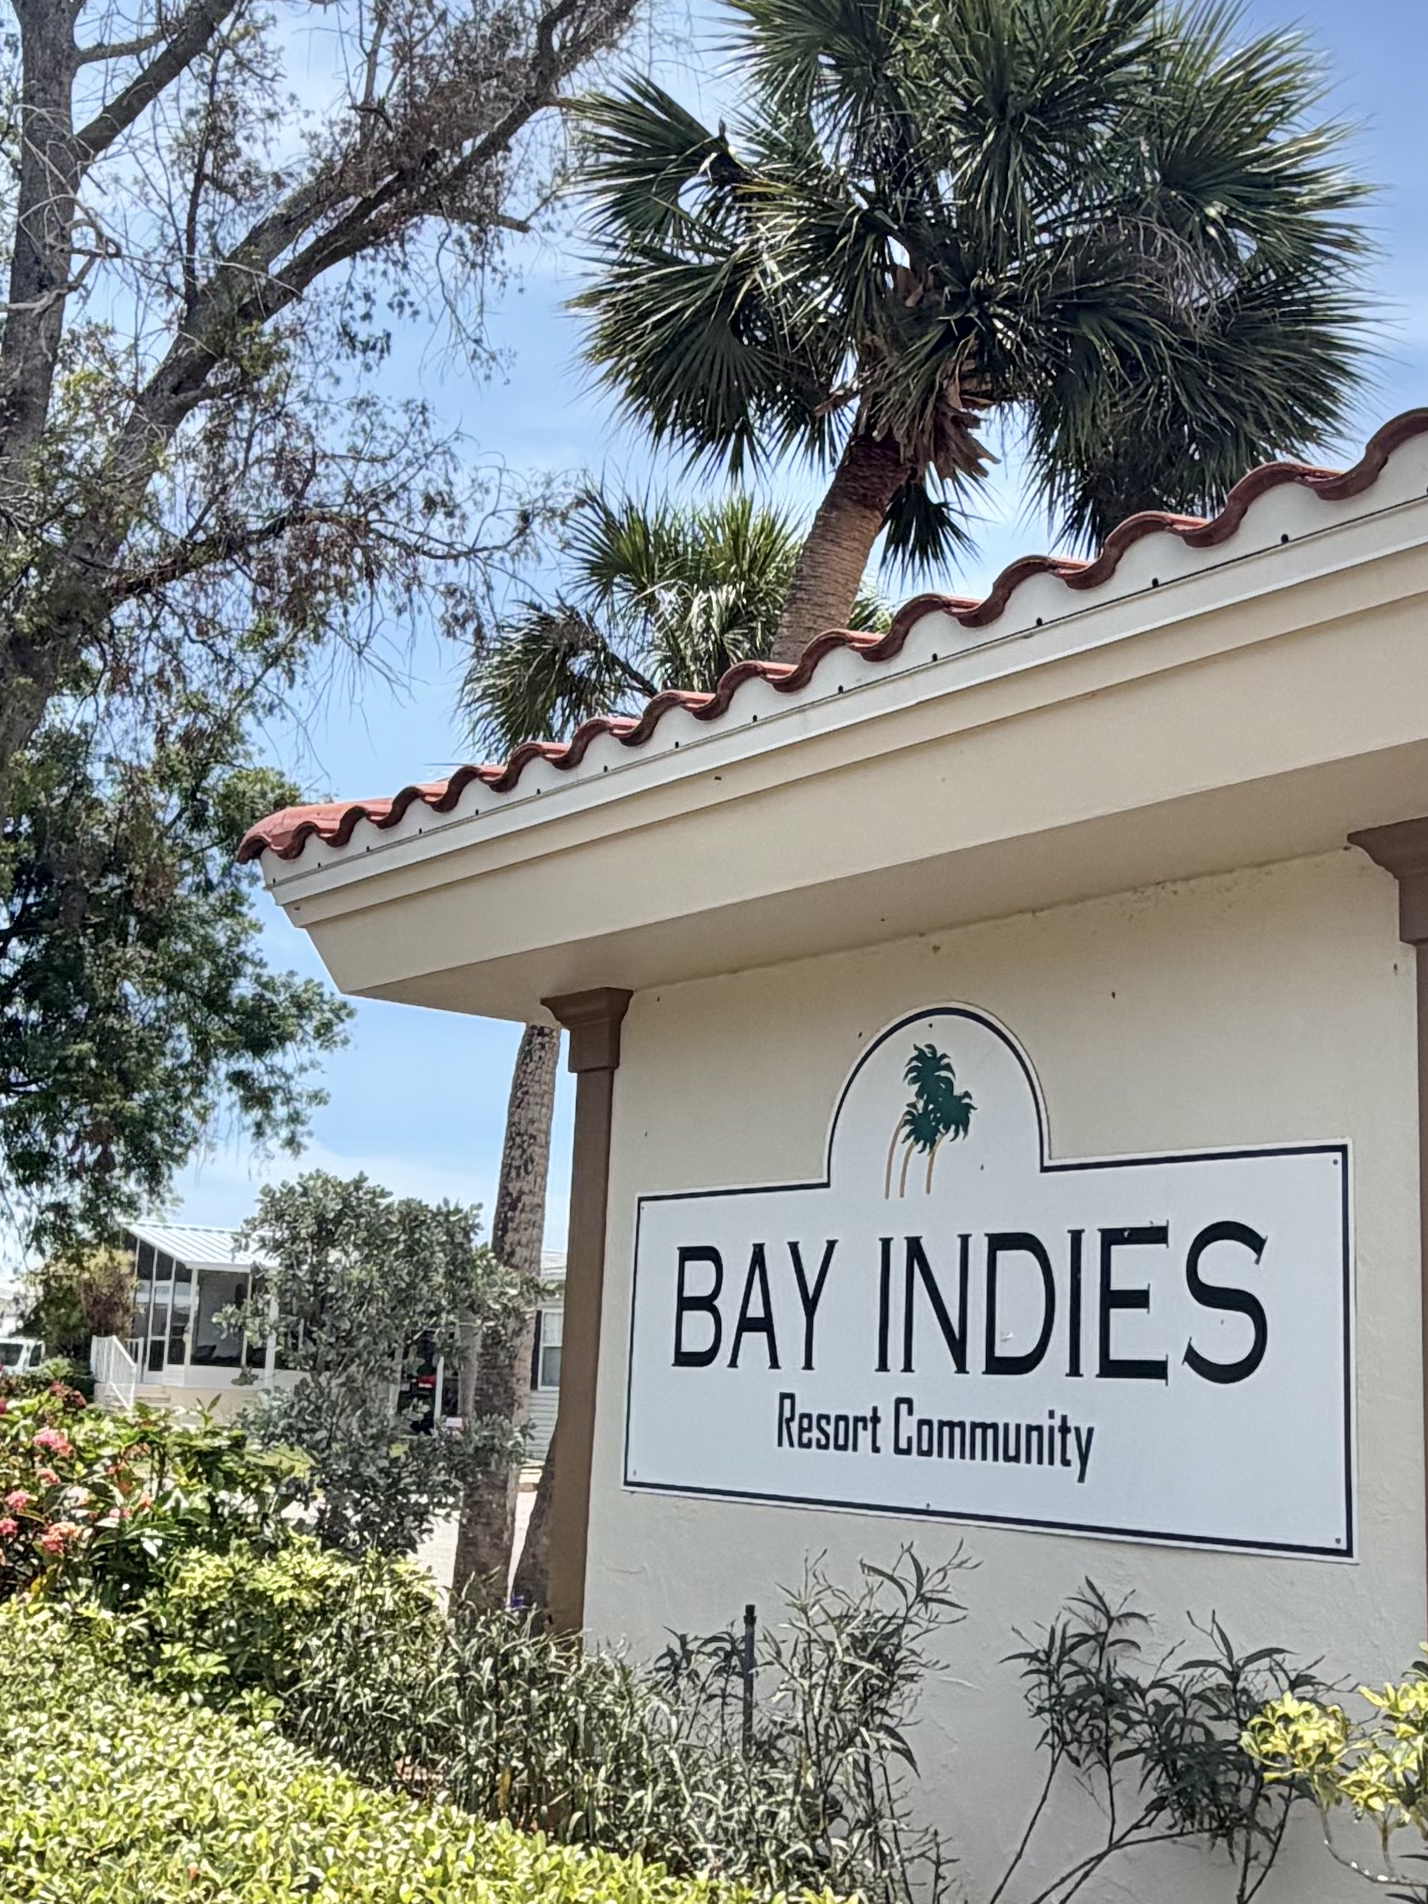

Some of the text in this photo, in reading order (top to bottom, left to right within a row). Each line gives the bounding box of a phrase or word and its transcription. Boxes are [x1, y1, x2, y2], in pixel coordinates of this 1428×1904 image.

[671, 1219, 1269, 1386] BAY INDIES
[777, 1392, 1095, 1484] Resort Community
